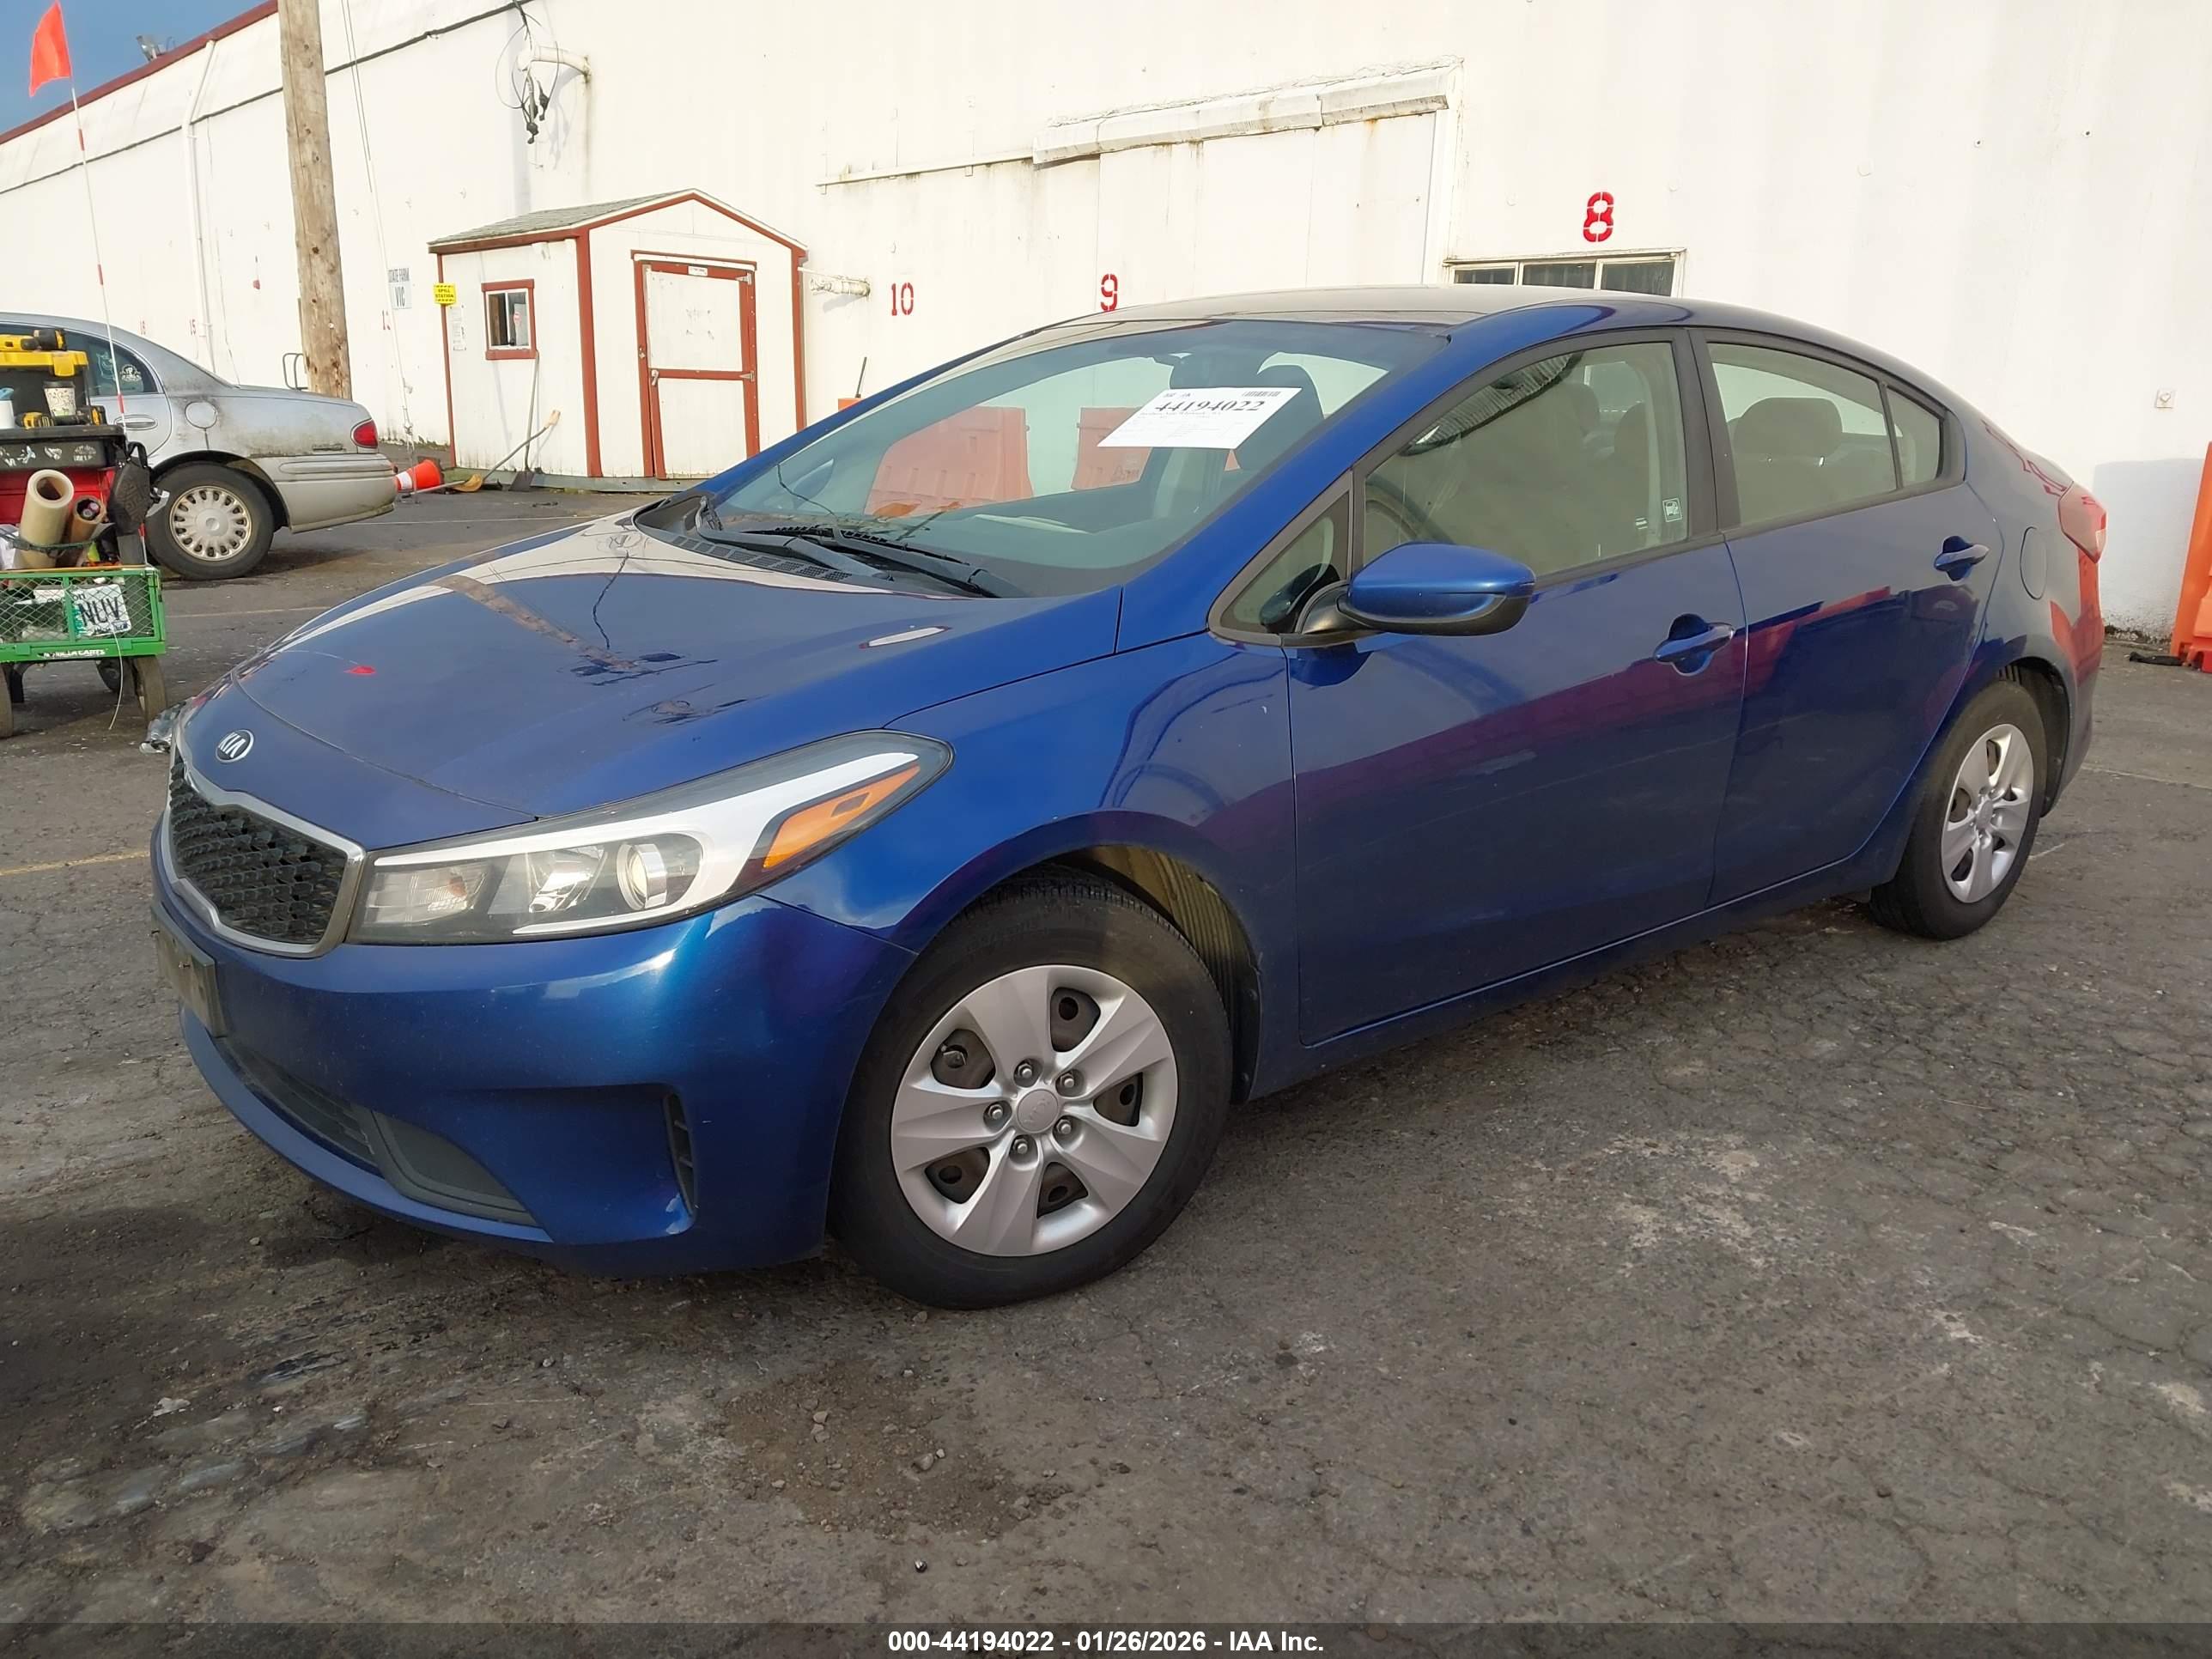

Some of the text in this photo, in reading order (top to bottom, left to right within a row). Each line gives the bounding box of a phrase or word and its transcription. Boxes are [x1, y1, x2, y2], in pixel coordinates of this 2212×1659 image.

[1582, 191, 1615, 244] 8
[395, 286, 405, 307] VIC
[891, 283, 915, 317] 10
[1101, 274, 1120, 313] 9
[189, 319, 197, 336] 15
[1153, 399, 1266, 412] 44194022
[78, 596, 120, 627] NUV
[217, 731, 248, 760] KIA
